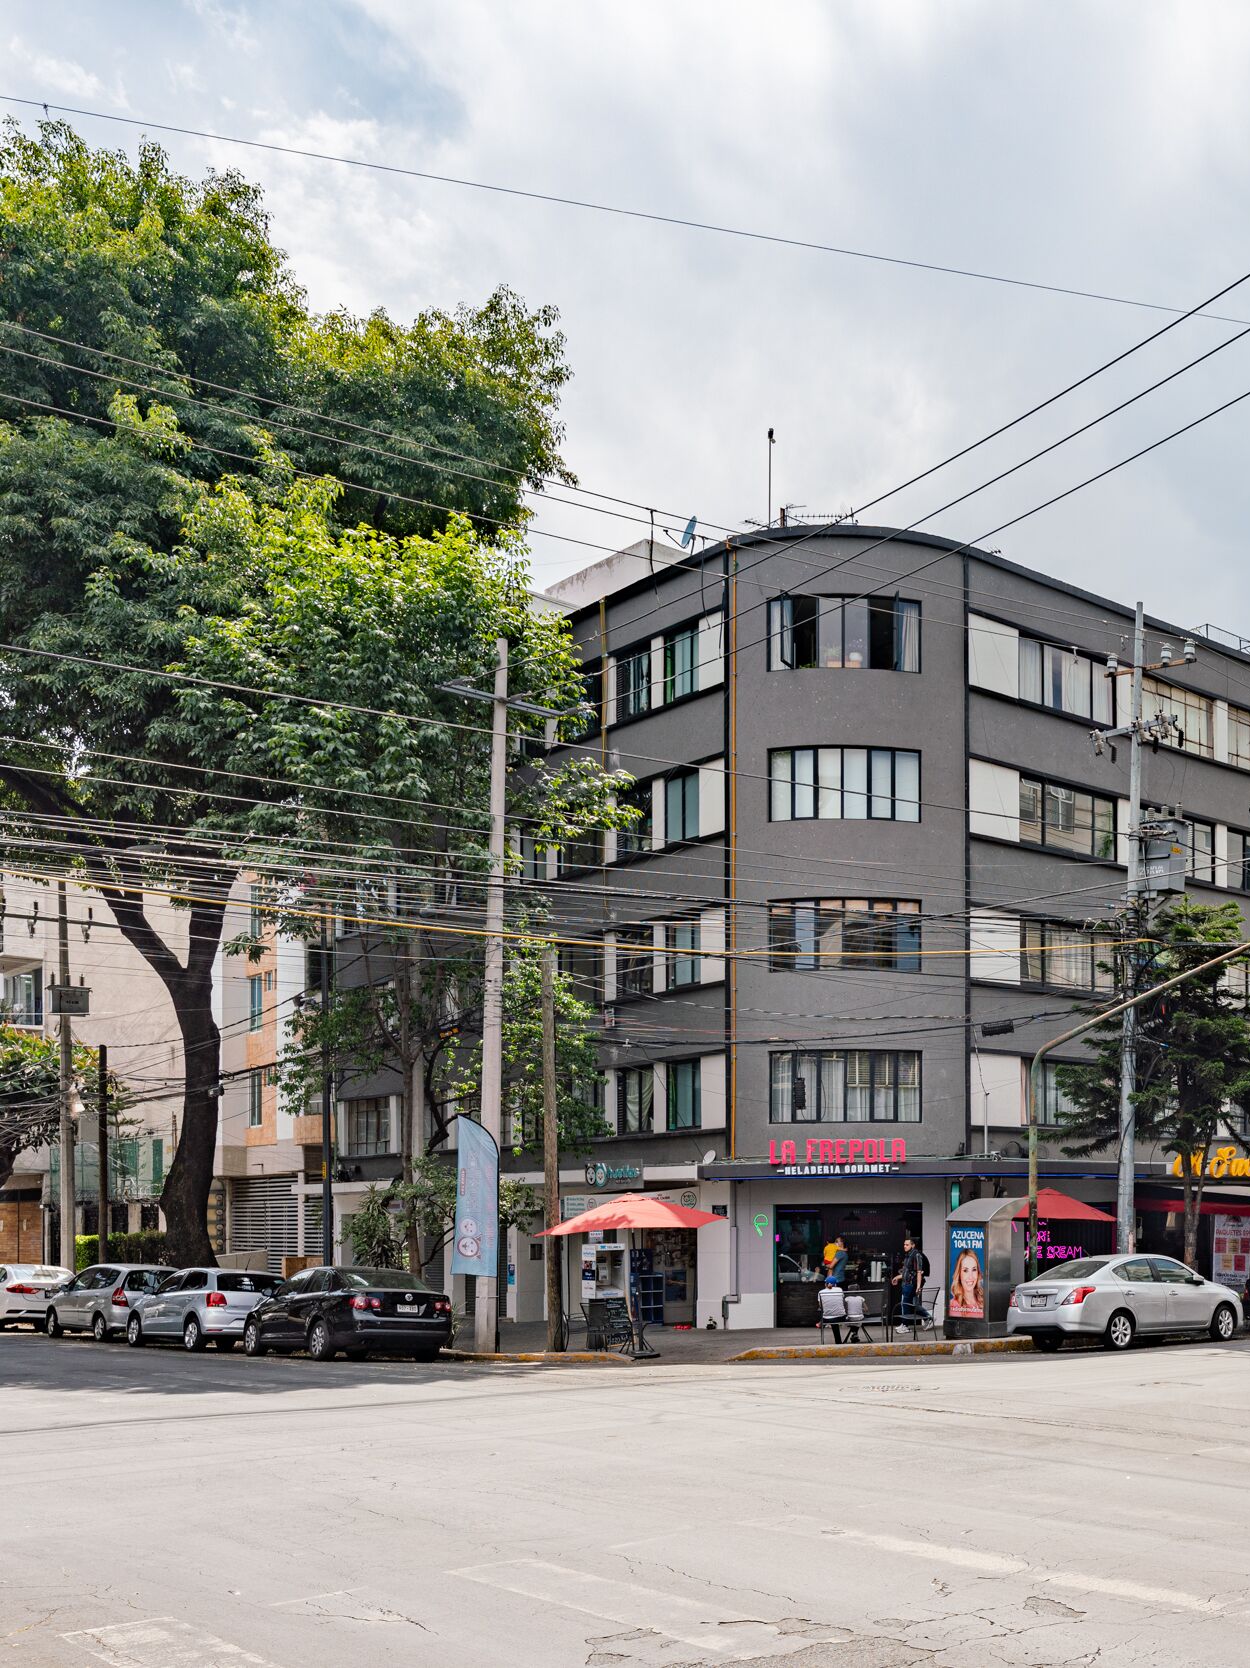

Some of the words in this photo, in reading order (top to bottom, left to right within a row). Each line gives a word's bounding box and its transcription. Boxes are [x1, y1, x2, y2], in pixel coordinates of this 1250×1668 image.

[769, 1139, 797, 1164] LA
[806, 1138, 907, 1164] FREPOLA
[785, 1165, 841, 1175] HELADERIA
[844, 1164, 891, 1173] GOURMET
[952, 1231, 984, 1239] AZUCENA
[953, 1240, 970, 1248] 104.1
[971, 1240, 983, 1248] FM
